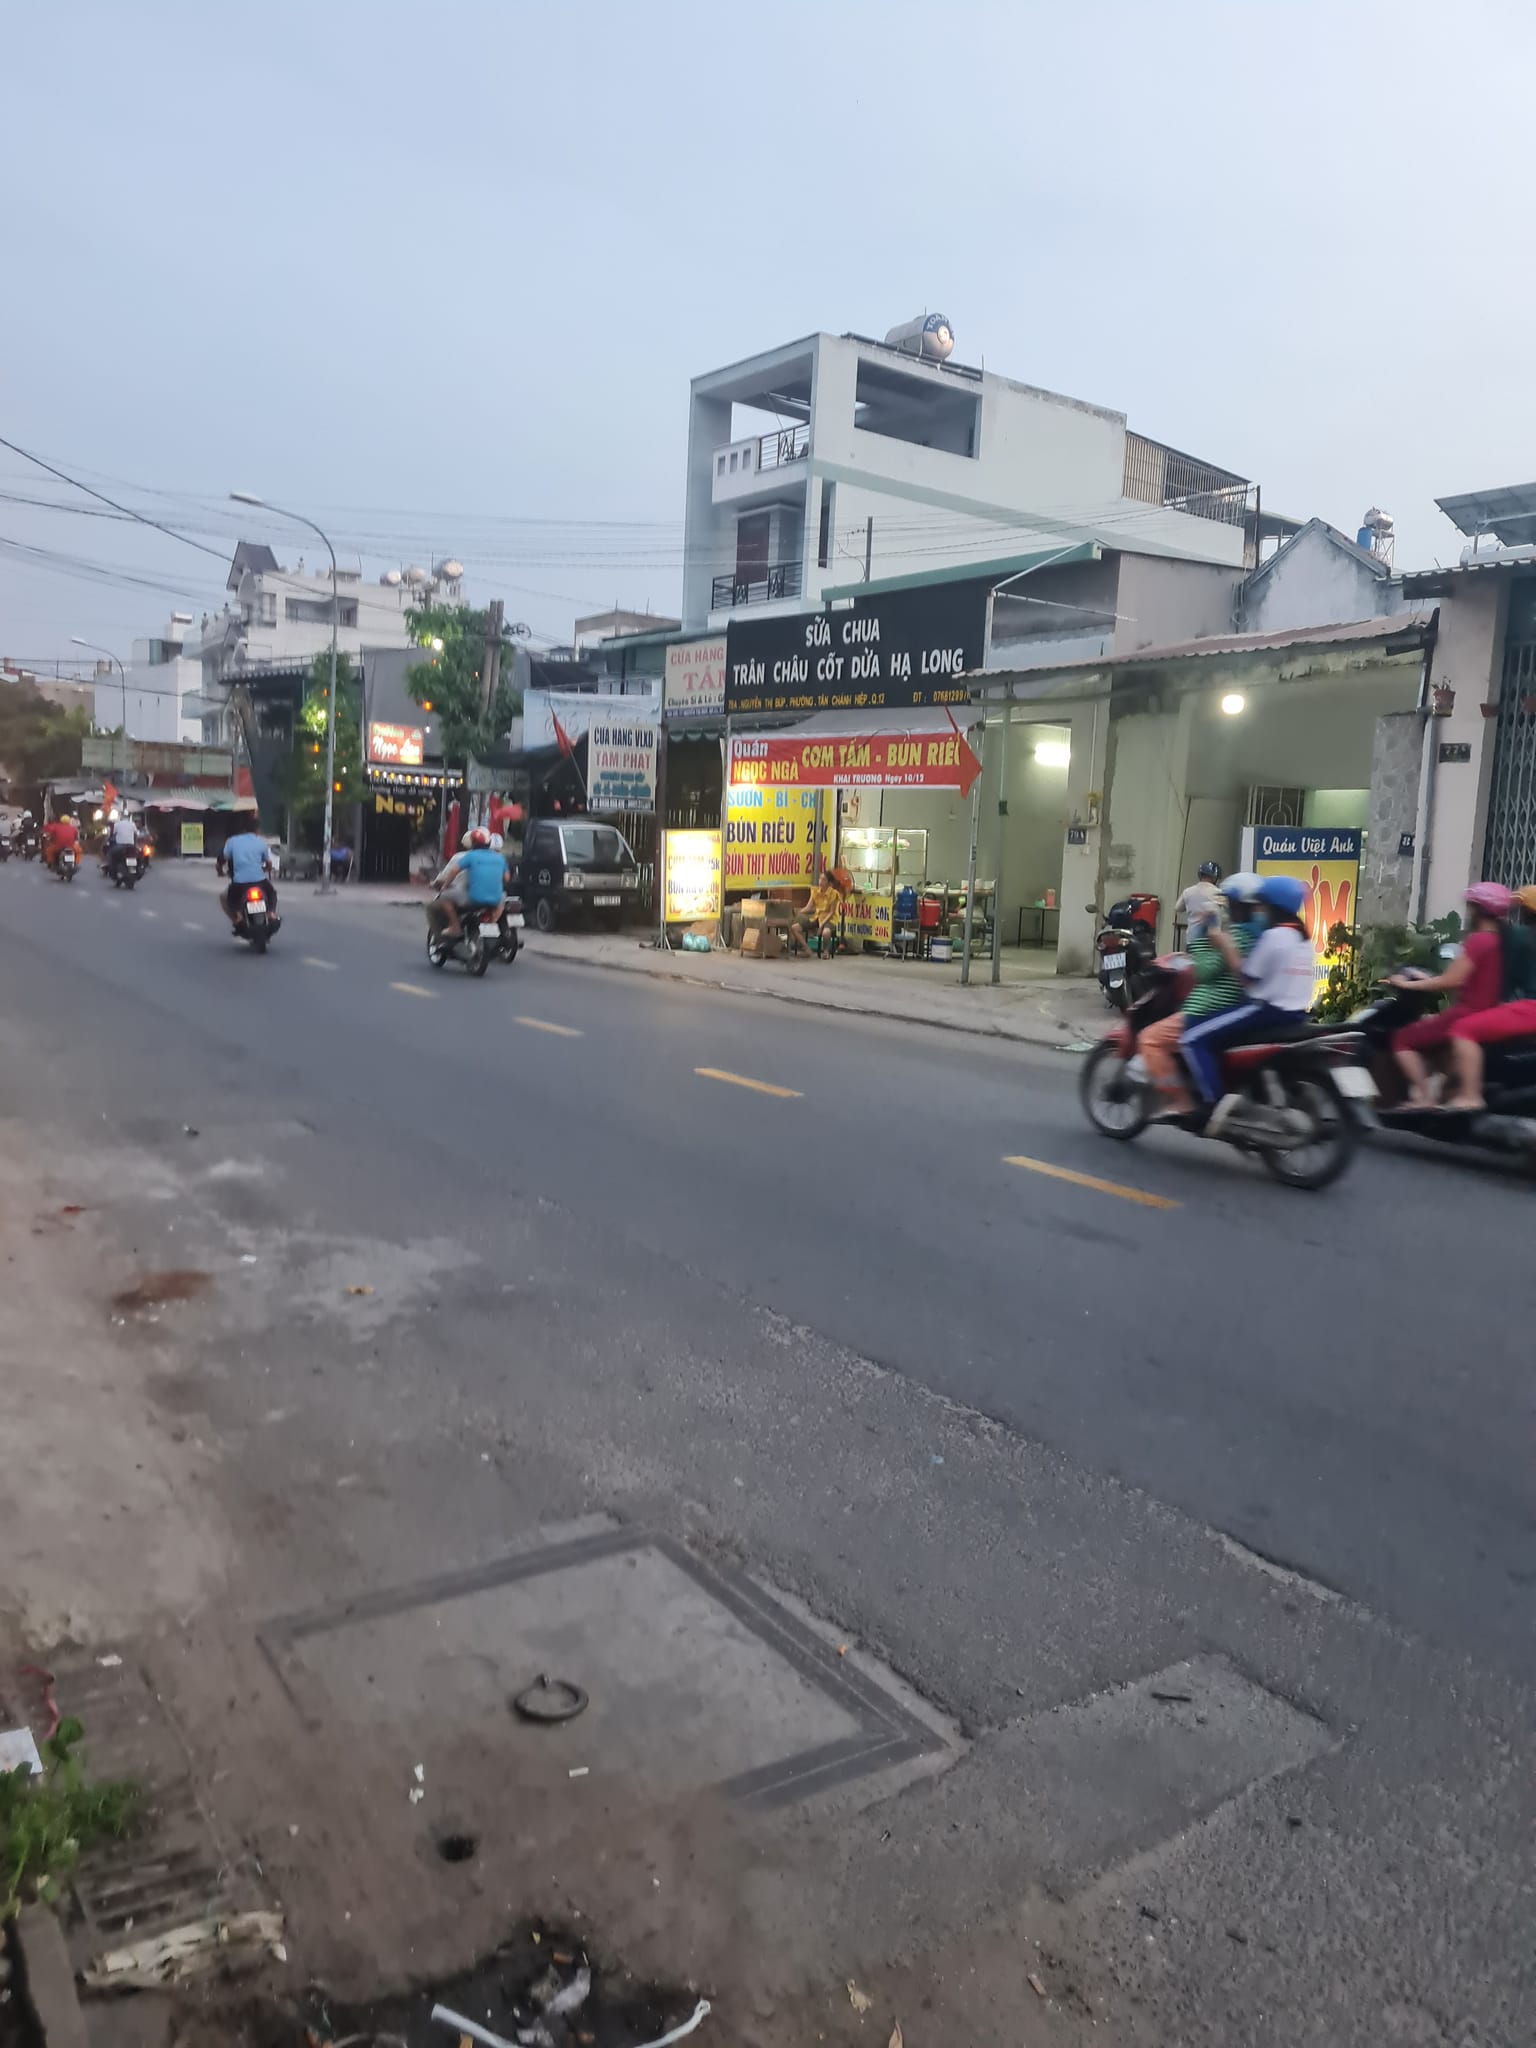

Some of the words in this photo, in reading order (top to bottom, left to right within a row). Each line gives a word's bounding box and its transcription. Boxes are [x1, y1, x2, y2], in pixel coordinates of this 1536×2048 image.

[805, 615, 831, 647] SỮA
[843, 618, 880, 645] CHUA
[733, 657, 765, 686] TRÂN
[773, 654, 808, 682] CHÂU
[817, 652, 844, 680] CỐT
[851, 647, 880, 679] DỪA
[890, 652, 911, 681] HẠ
[921, 648, 963, 674] LONG
[801, 745, 834, 768] CƠM
[887, 738, 922, 767] BÚN
[771, 756, 799, 781] NGÀ
[726, 816, 757, 843] BÚN
[762, 816, 795, 843] RIÊU
[1263, 836, 1297, 855] Quán
[1301, 837, 1327, 857] Việt
[1330, 837, 1355, 853] Anh
[725, 848, 744, 875] BÚN
[747, 853, 766, 880] THỊT
[769, 848, 800, 876] NƯỚNG
